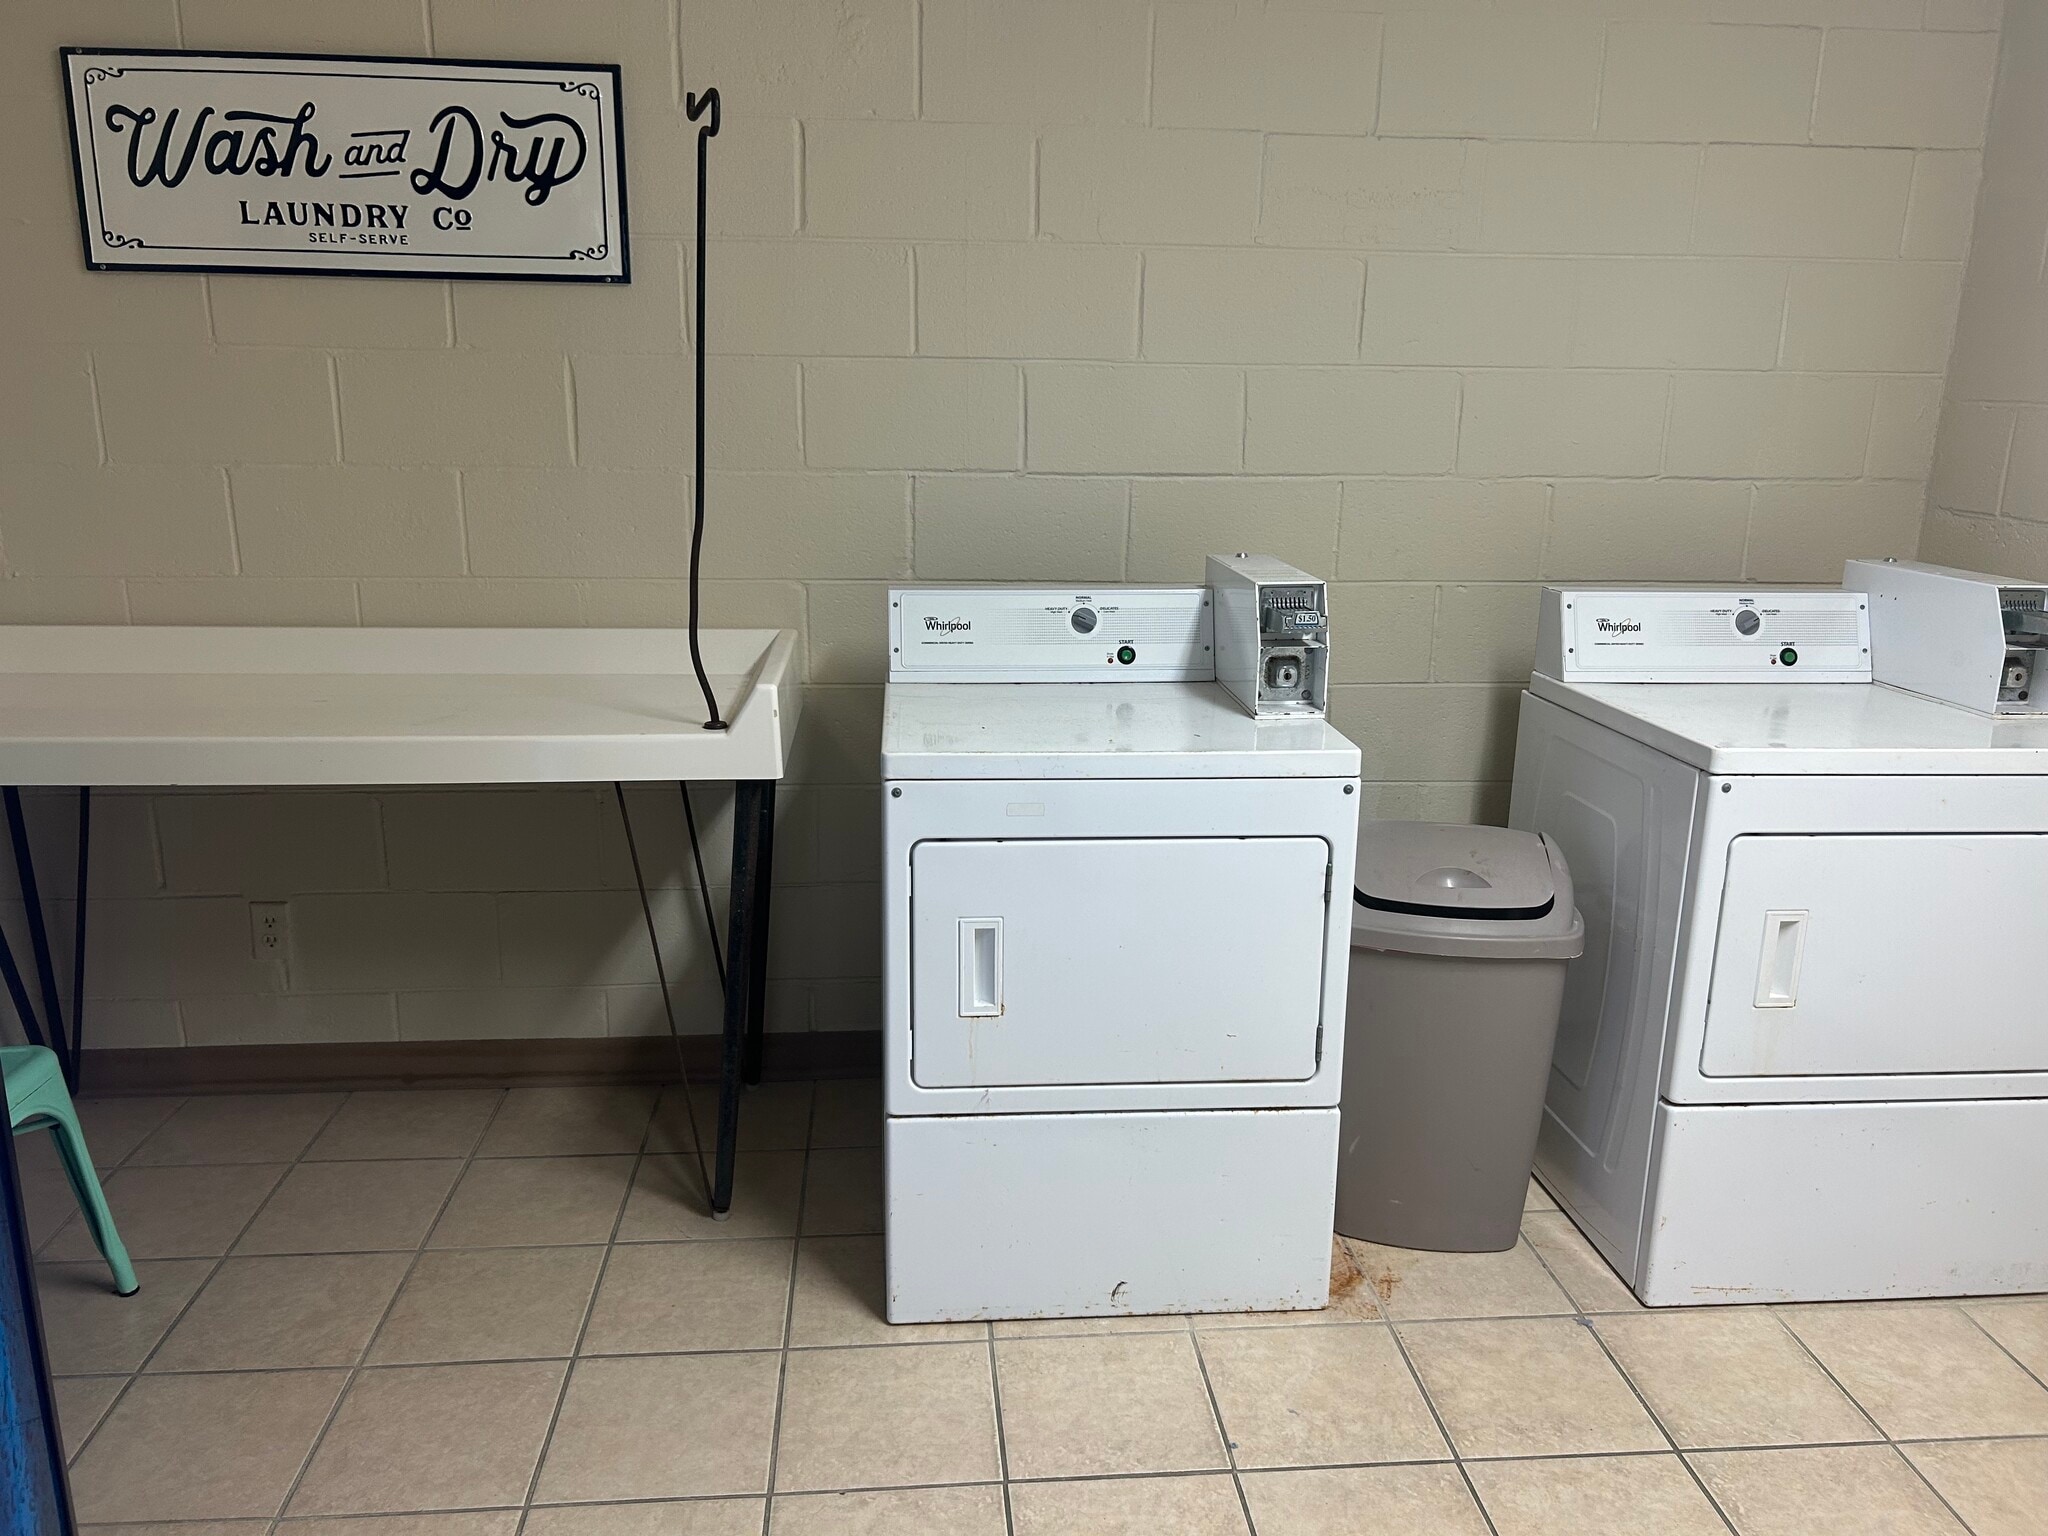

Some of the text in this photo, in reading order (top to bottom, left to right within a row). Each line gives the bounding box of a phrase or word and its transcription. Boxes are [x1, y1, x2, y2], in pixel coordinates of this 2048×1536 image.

[106, 102, 587, 206] Wash and Dry
[239, 201, 472, 231] LAUNDRY Co
[309, 232, 409, 245] SELF-SERVE
[925, 621, 971, 632] Whirlpool
[1598, 622, 1641, 634] Whirlpool
